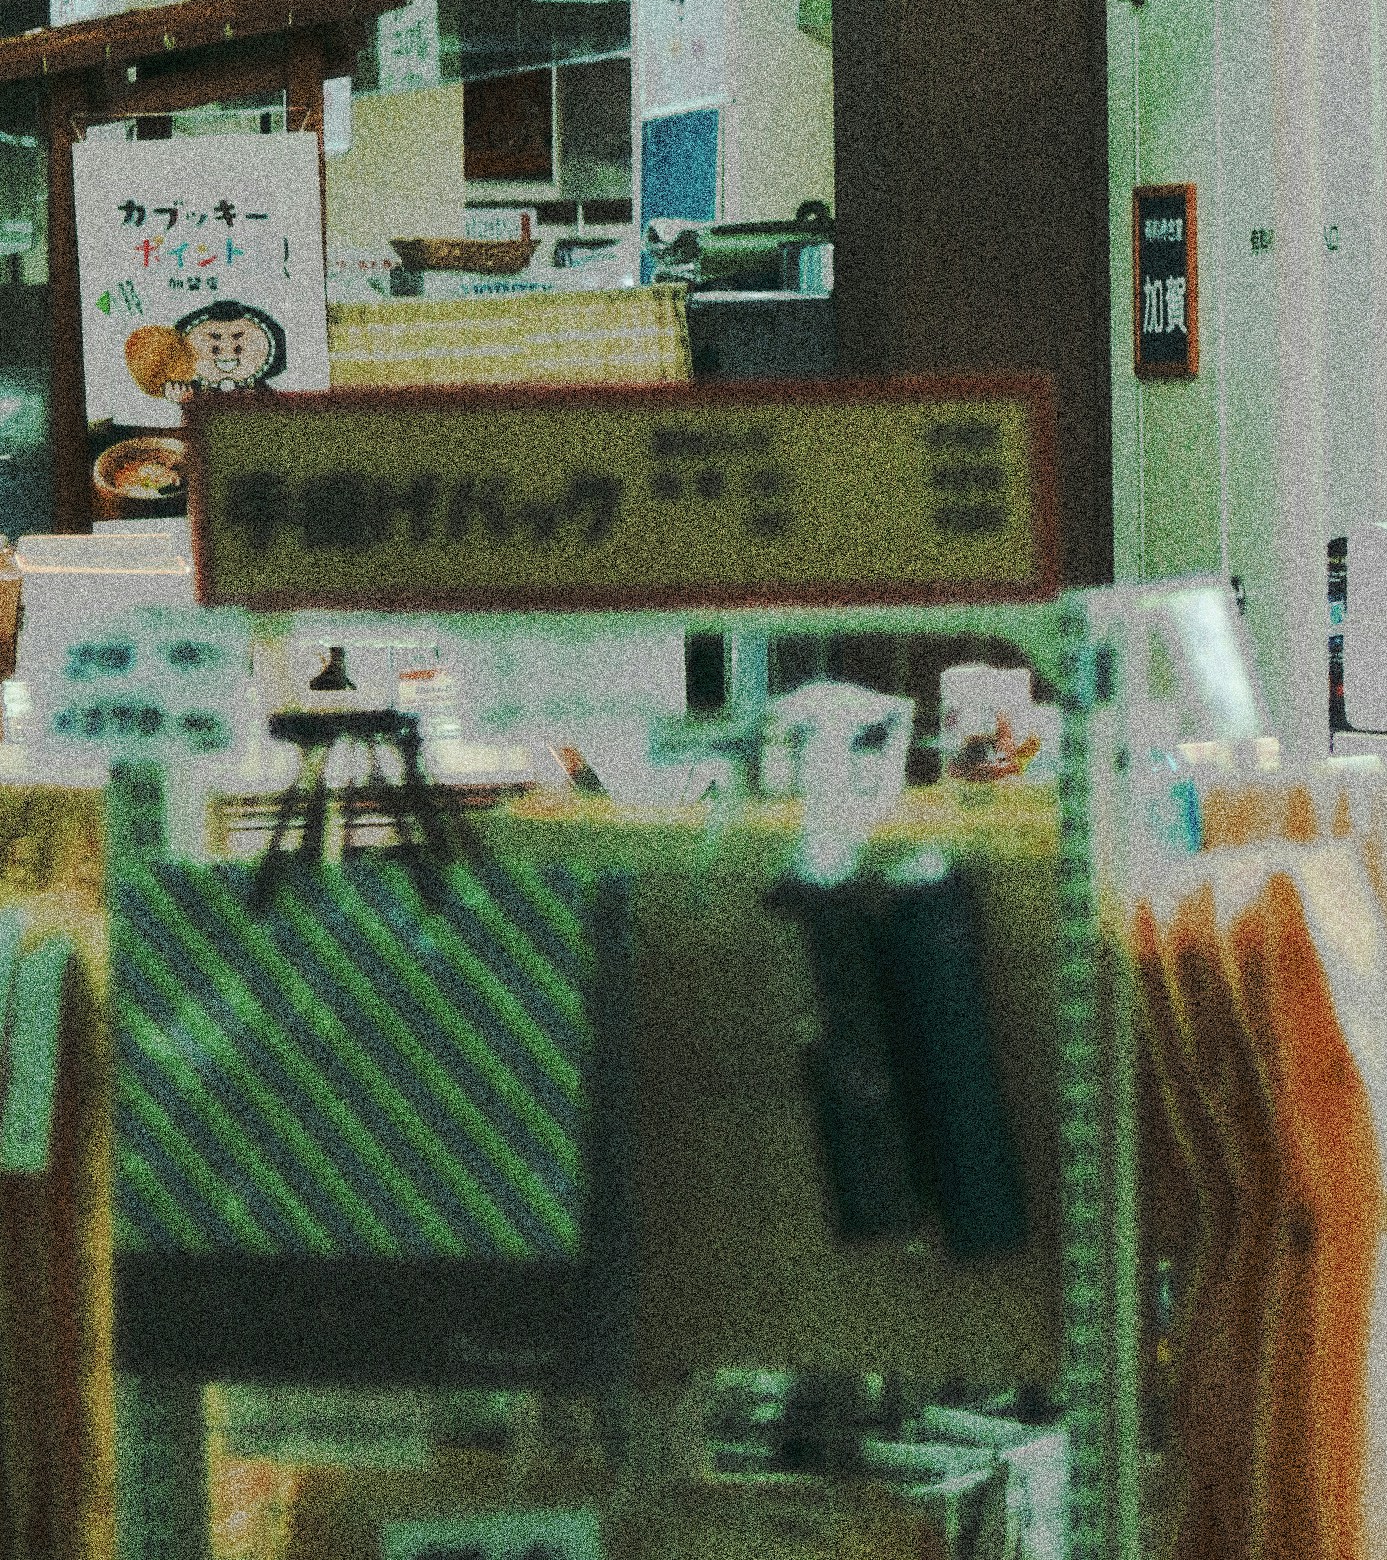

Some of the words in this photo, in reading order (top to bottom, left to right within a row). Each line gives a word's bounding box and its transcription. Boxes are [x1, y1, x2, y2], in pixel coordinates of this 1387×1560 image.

[117, 197, 269, 230] カブッキー
[135, 235, 246, 269] ポイント
[1142, 274, 1188, 335] 加賀
